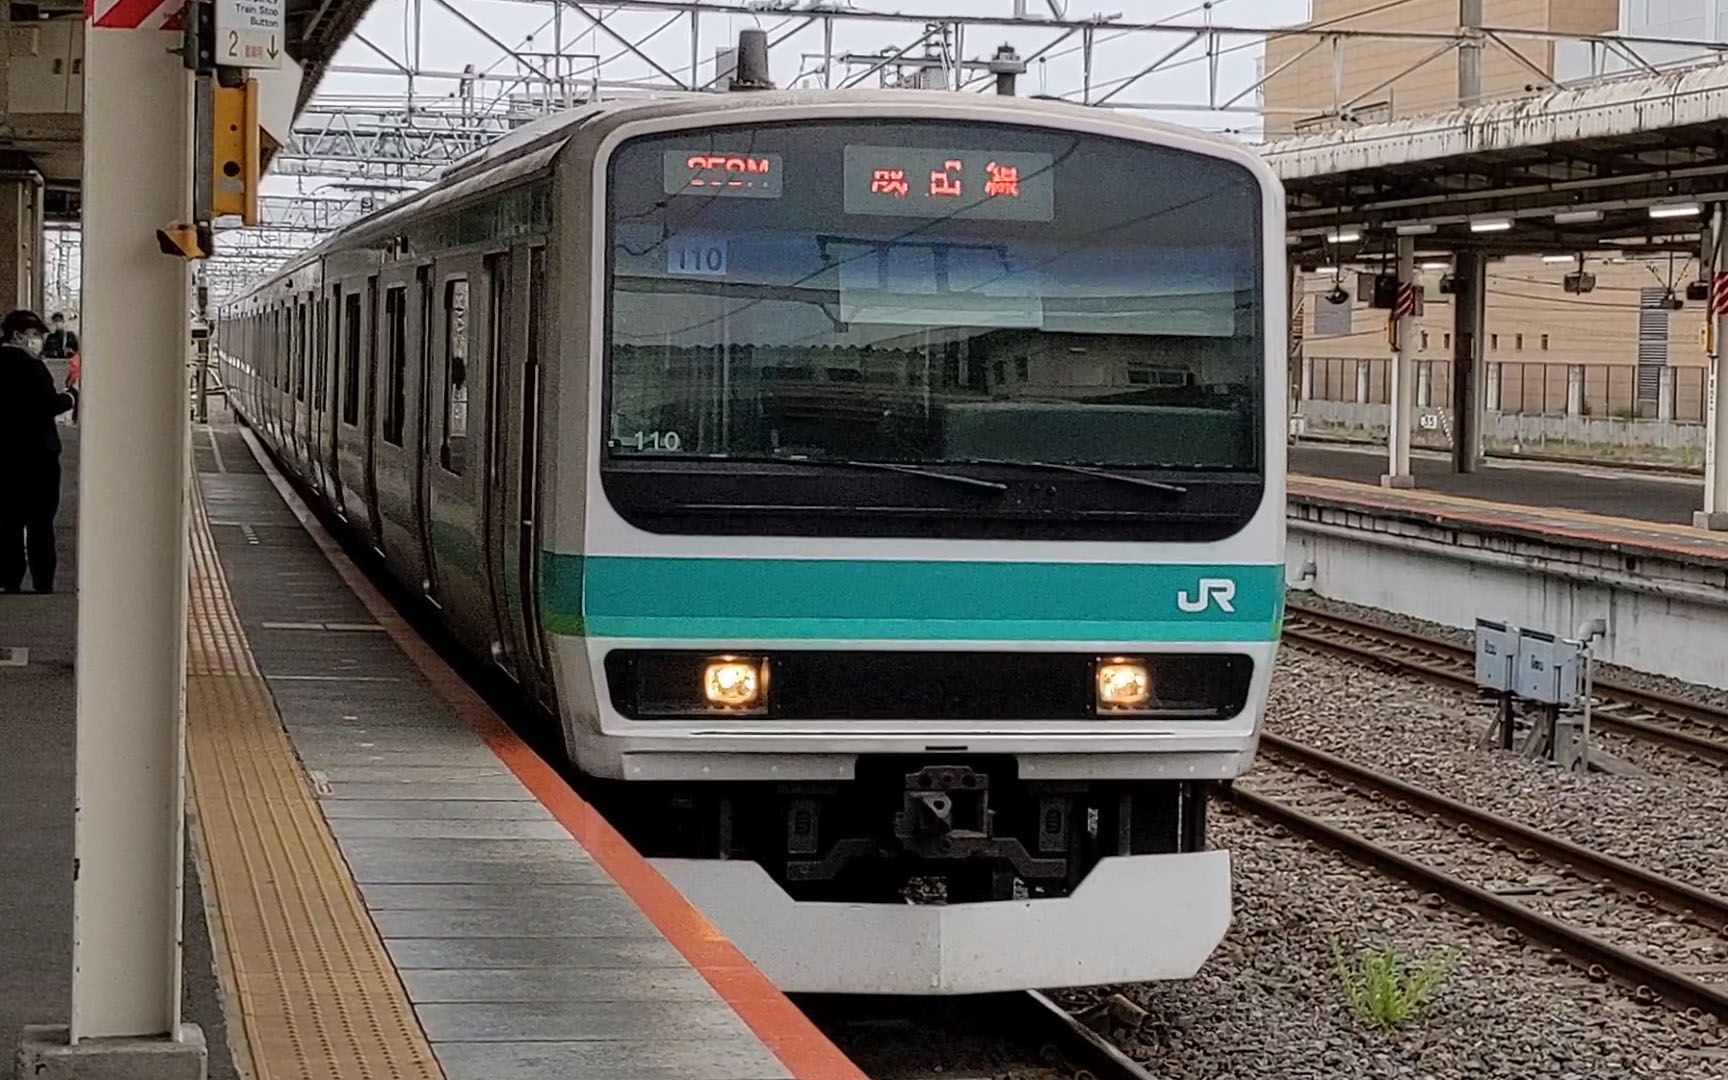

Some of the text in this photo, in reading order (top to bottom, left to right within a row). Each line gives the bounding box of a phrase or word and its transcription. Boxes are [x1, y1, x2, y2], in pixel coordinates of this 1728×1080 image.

[235, 3, 279, 16] Train Stop
[250, 16, 279, 28] Button
[228, 30, 239, 57] 2
[679, 247, 723, 272] 110
[634, 431, 680, 452] 110
[1177, 578, 1236, 613] JR
